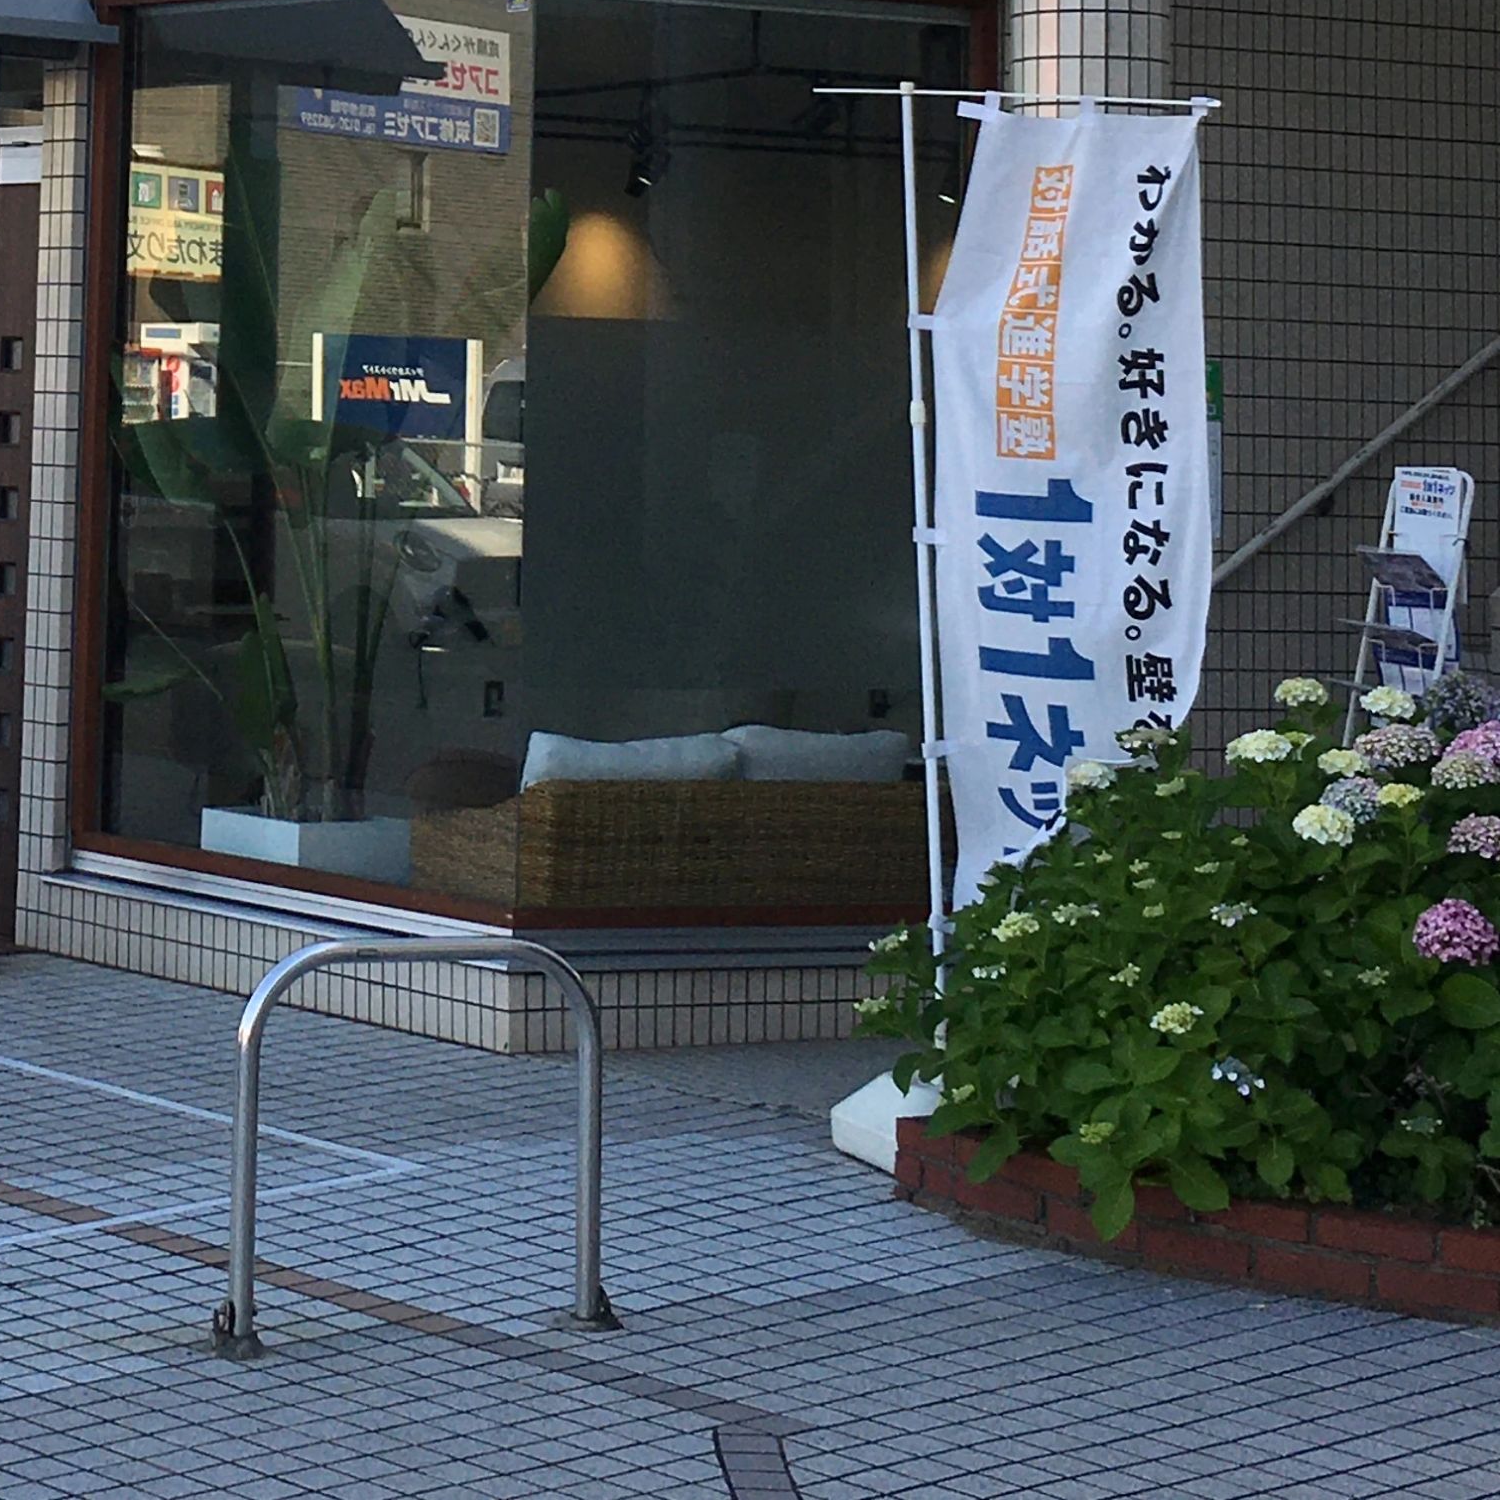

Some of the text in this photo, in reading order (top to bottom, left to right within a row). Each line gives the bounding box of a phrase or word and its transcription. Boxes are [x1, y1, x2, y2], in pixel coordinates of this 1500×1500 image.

[996, 164, 1073, 459] 対話式進学塾
[975, 478, 1096, 855] 1対1ネッ
